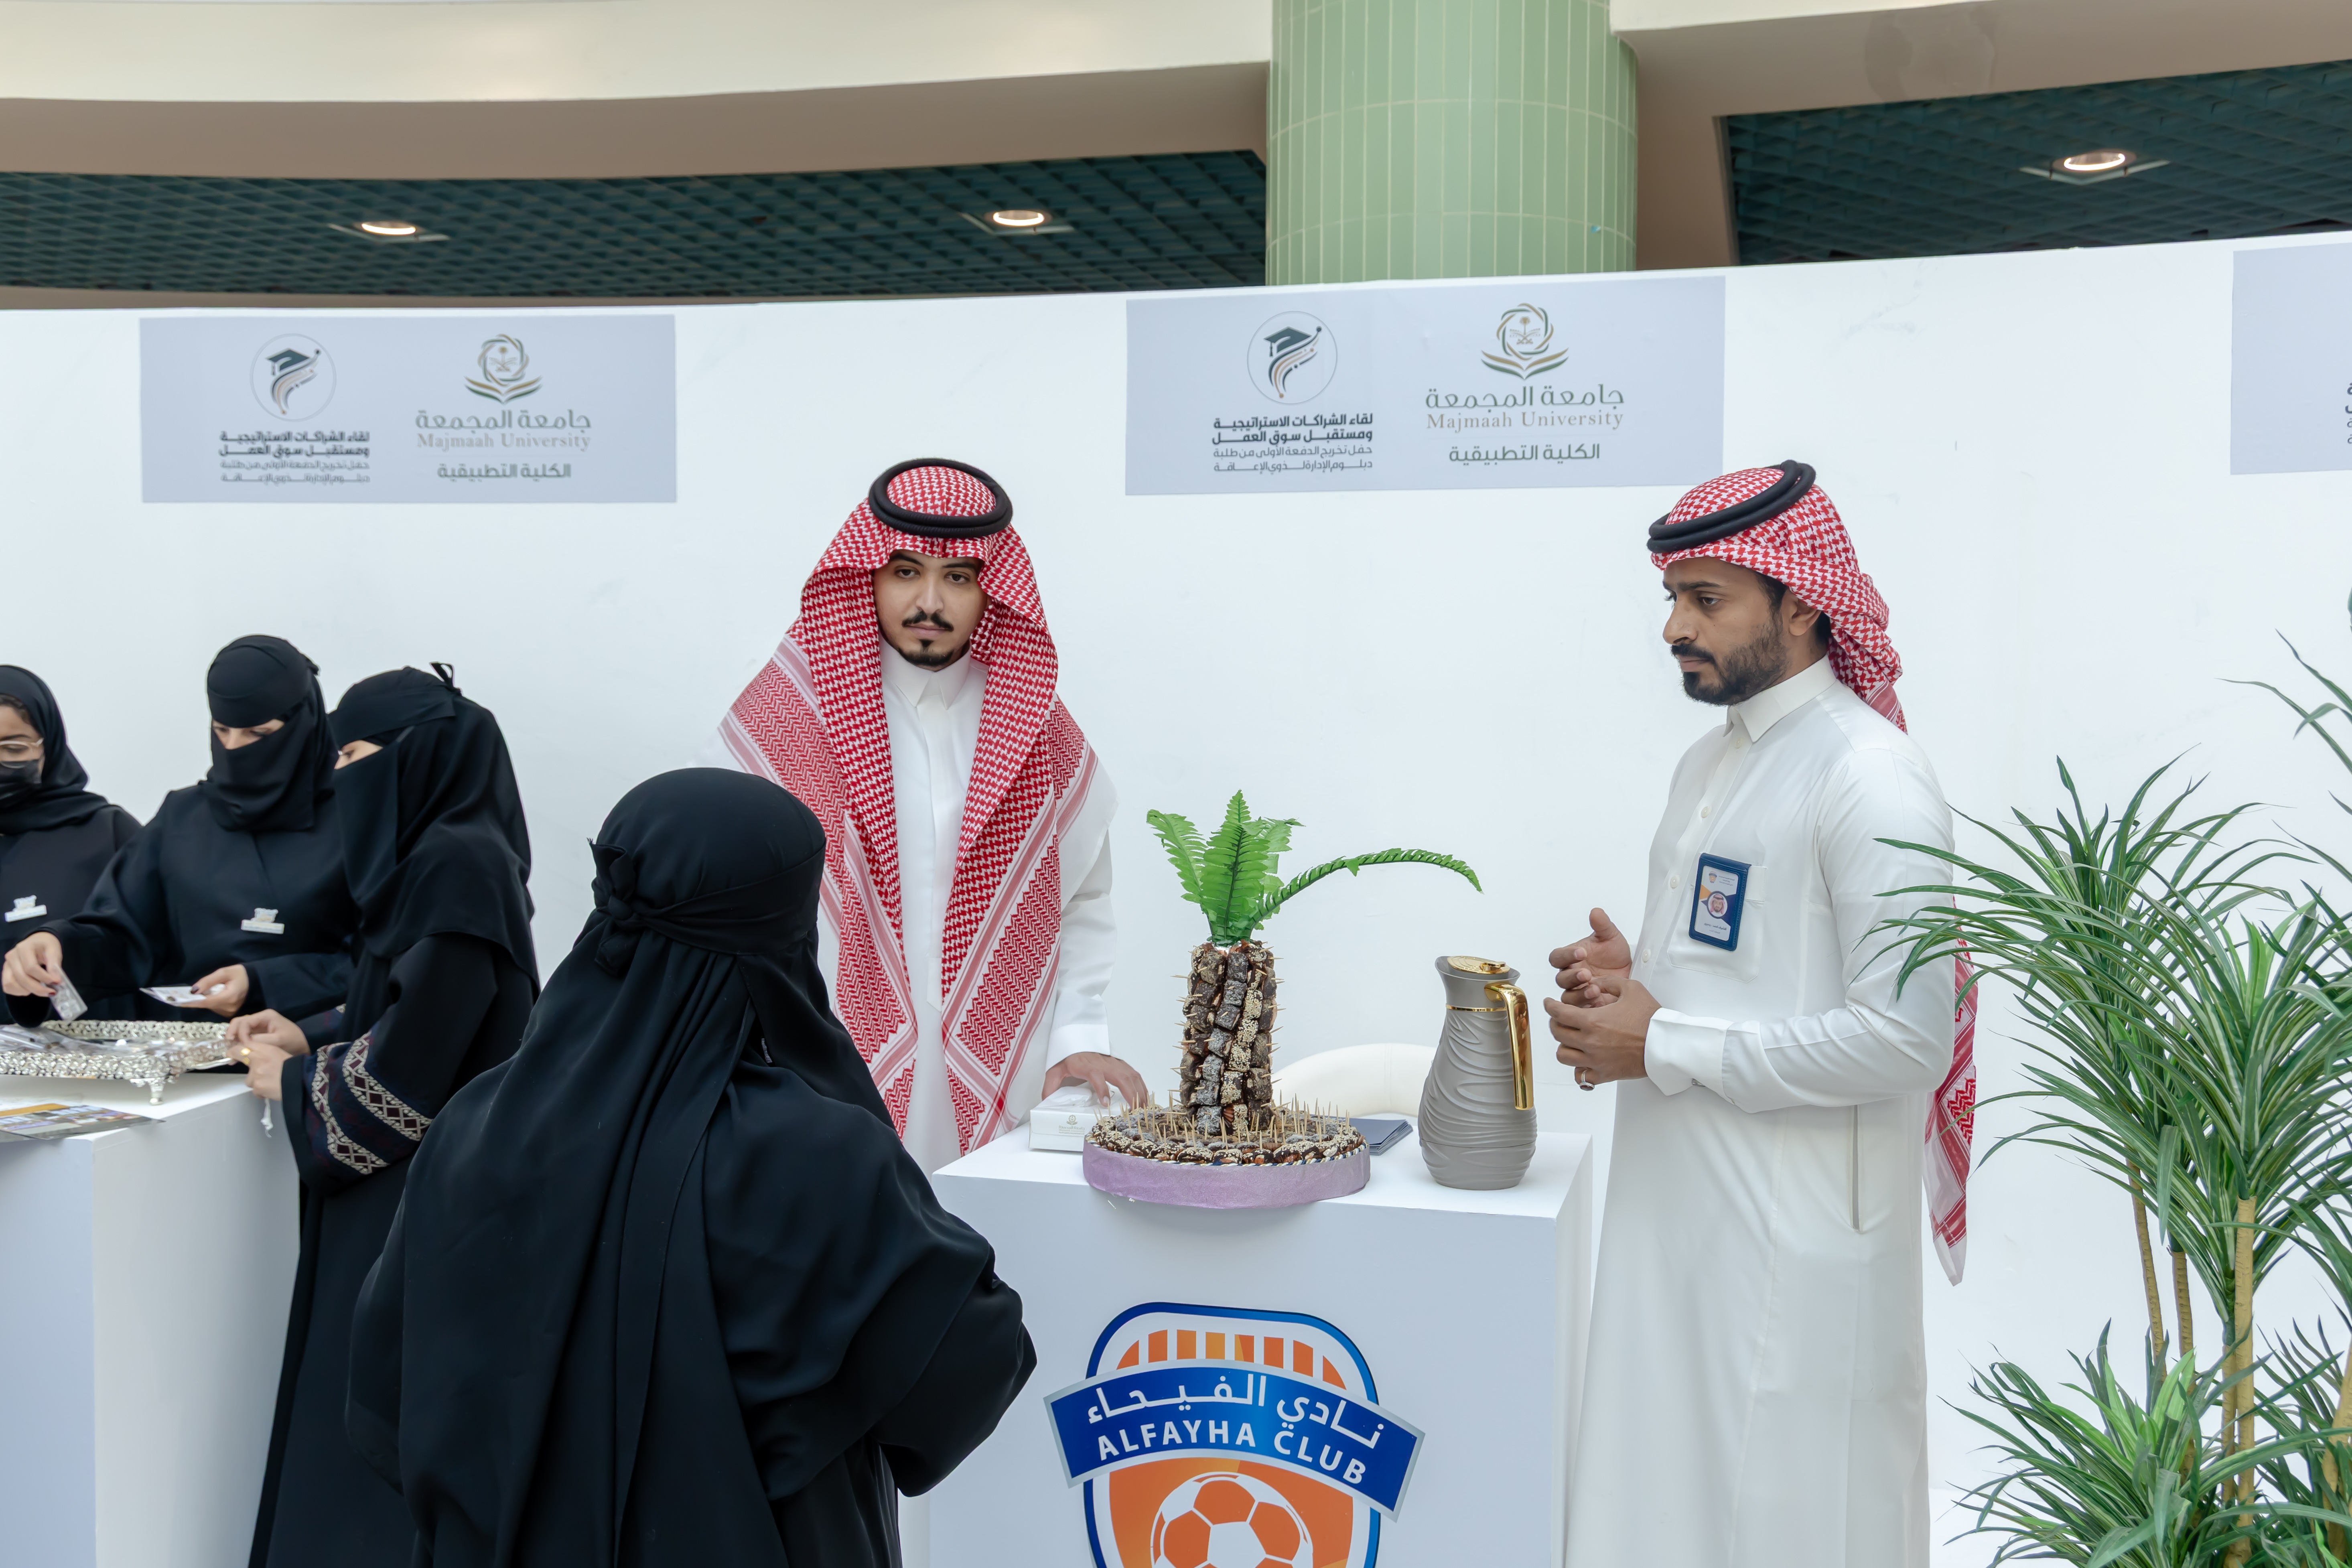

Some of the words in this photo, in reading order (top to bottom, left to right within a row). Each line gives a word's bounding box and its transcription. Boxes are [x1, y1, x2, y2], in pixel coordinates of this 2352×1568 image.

[1426, 386, 1533, 413] المجمعة
[1540, 384, 1624, 410] جامعة
[415, 410, 513, 434] المجمعة
[517, 409, 592, 434] جامعة
[1214, 416, 1289, 431] الاستراتيجية
[1292, 413, 1346, 428] الشراكات
[1349, 413, 1373, 424] لقاء
[1427, 412, 1512, 433] Majmaah
[1522, 409, 1623, 430] University
[417, 432, 494, 452] Majmaah
[501, 432, 591, 452] University
[1212, 431, 1266, 445] العمل
[1269, 430, 1301, 444] سوق
[1303, 429, 1372, 442] ومستقبل
[1213, 448, 1238, 460] طلبة
[1239, 449, 1254, 458] من
[1256, 445, 1284, 458] الأولى
[1285, 446, 1319, 455] الدفعة
[1320, 444, 1347, 458] تخريج
[1348, 444, 1372, 455] حفل
[1449, 444, 1538, 466] التطبيقية
[1543, 443, 1600, 464] الكلية
[437, 463, 517, 482] التطبيقية
[520, 463, 571, 482] الكلية
[1088, 1373, 1267, 1424] الفيحاء
[1277, 1396, 1384, 1449] نادي
[1098, 1419, 1256, 1460] ALFAYHA
[1274, 1430, 1366, 1484] CLUB
